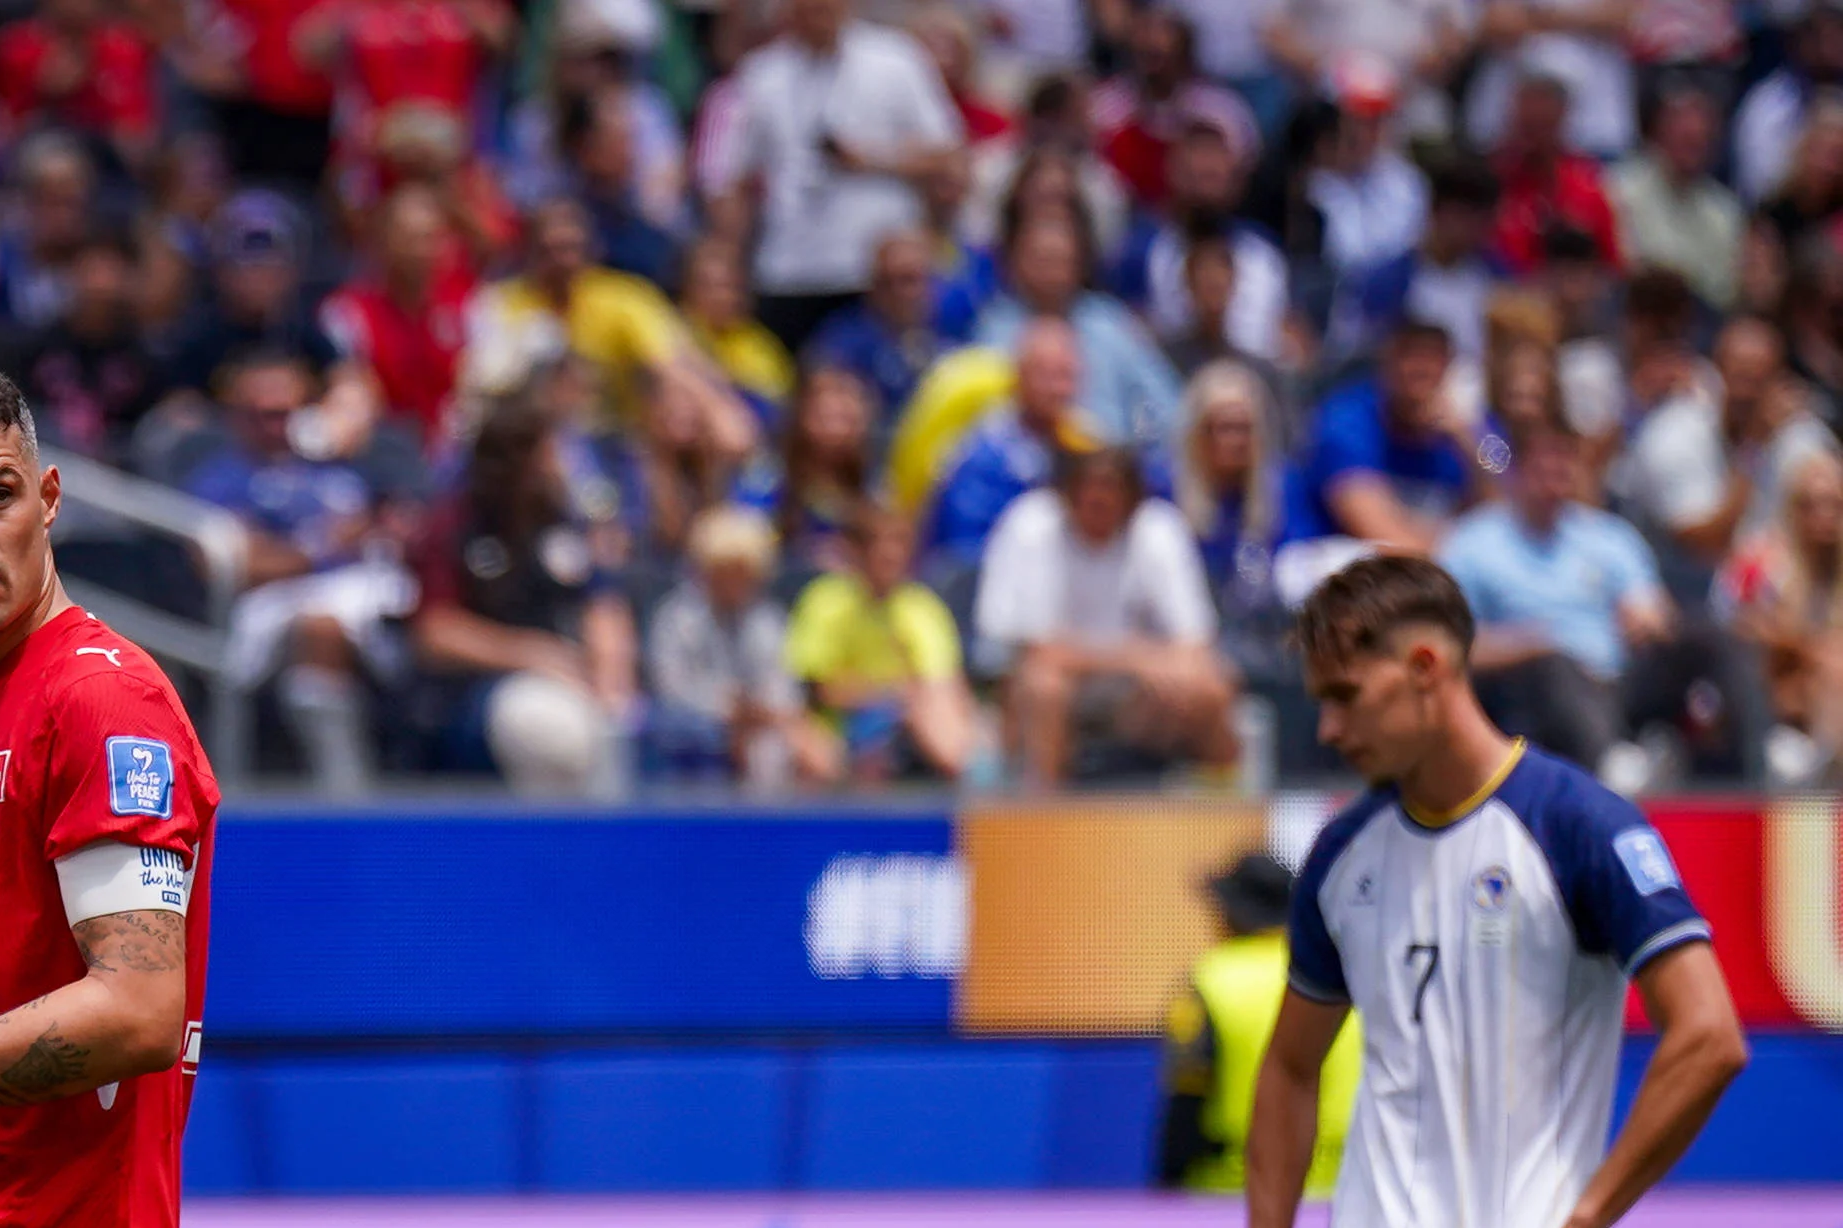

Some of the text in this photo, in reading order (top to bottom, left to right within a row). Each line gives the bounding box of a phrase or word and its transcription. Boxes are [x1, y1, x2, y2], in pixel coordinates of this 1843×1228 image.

[130, 783, 160, 801] PEACE
[139, 868, 164, 887] the
[1404, 943, 1440, 1025] 7
